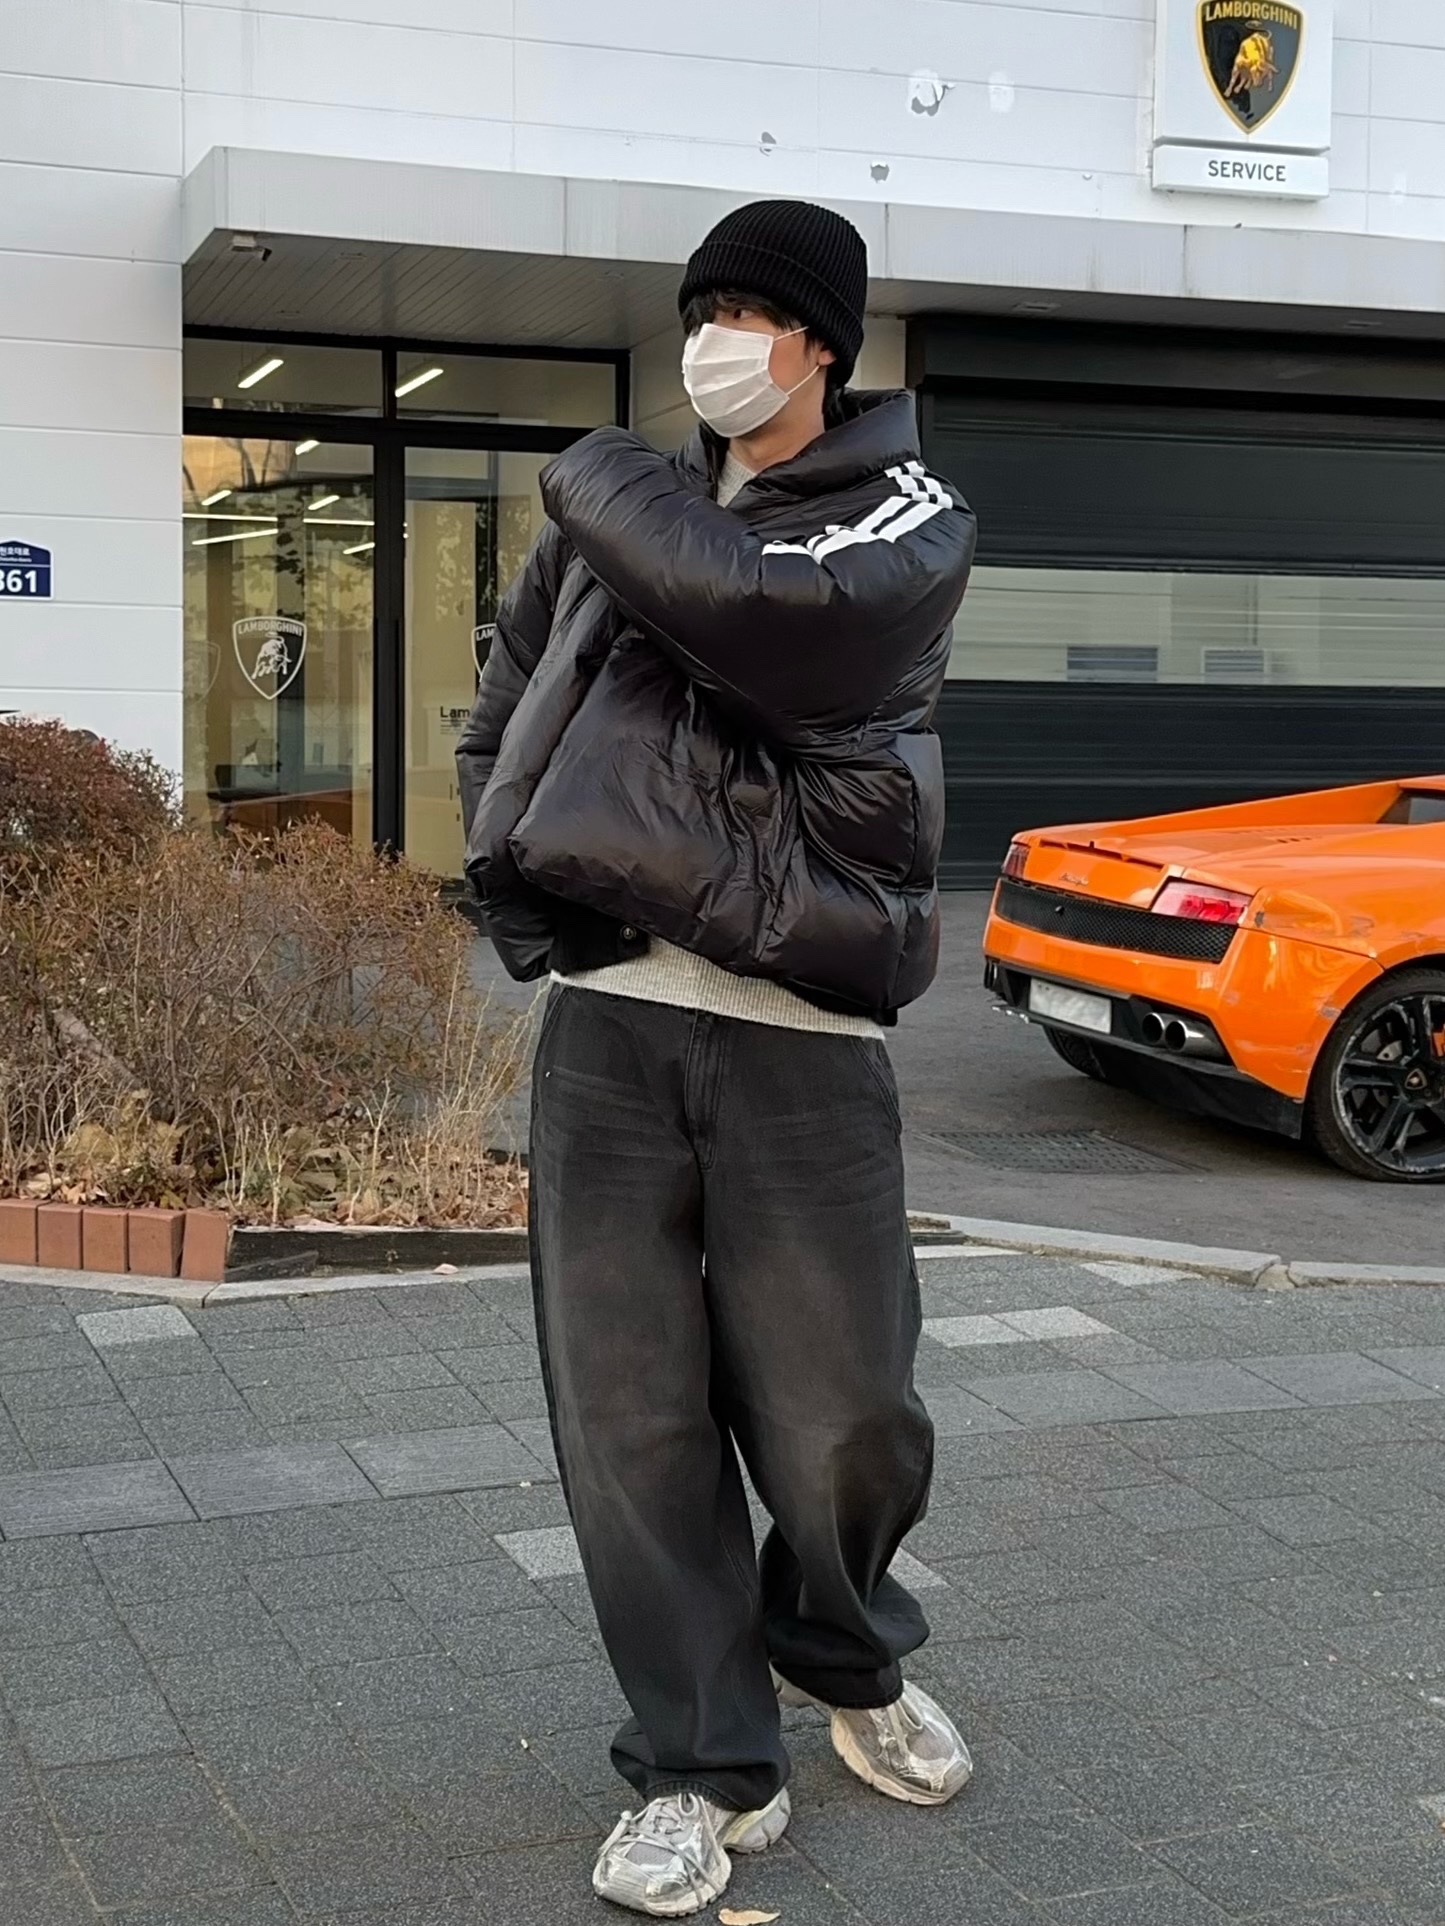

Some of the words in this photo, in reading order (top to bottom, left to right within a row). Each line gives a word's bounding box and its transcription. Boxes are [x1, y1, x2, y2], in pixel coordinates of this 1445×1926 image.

[1205, 1, 1298, 30] LAMBORGHINI
[1208, 160, 1286, 182] SERVICE
[238, 620, 302, 637] LAMBORGHINI
